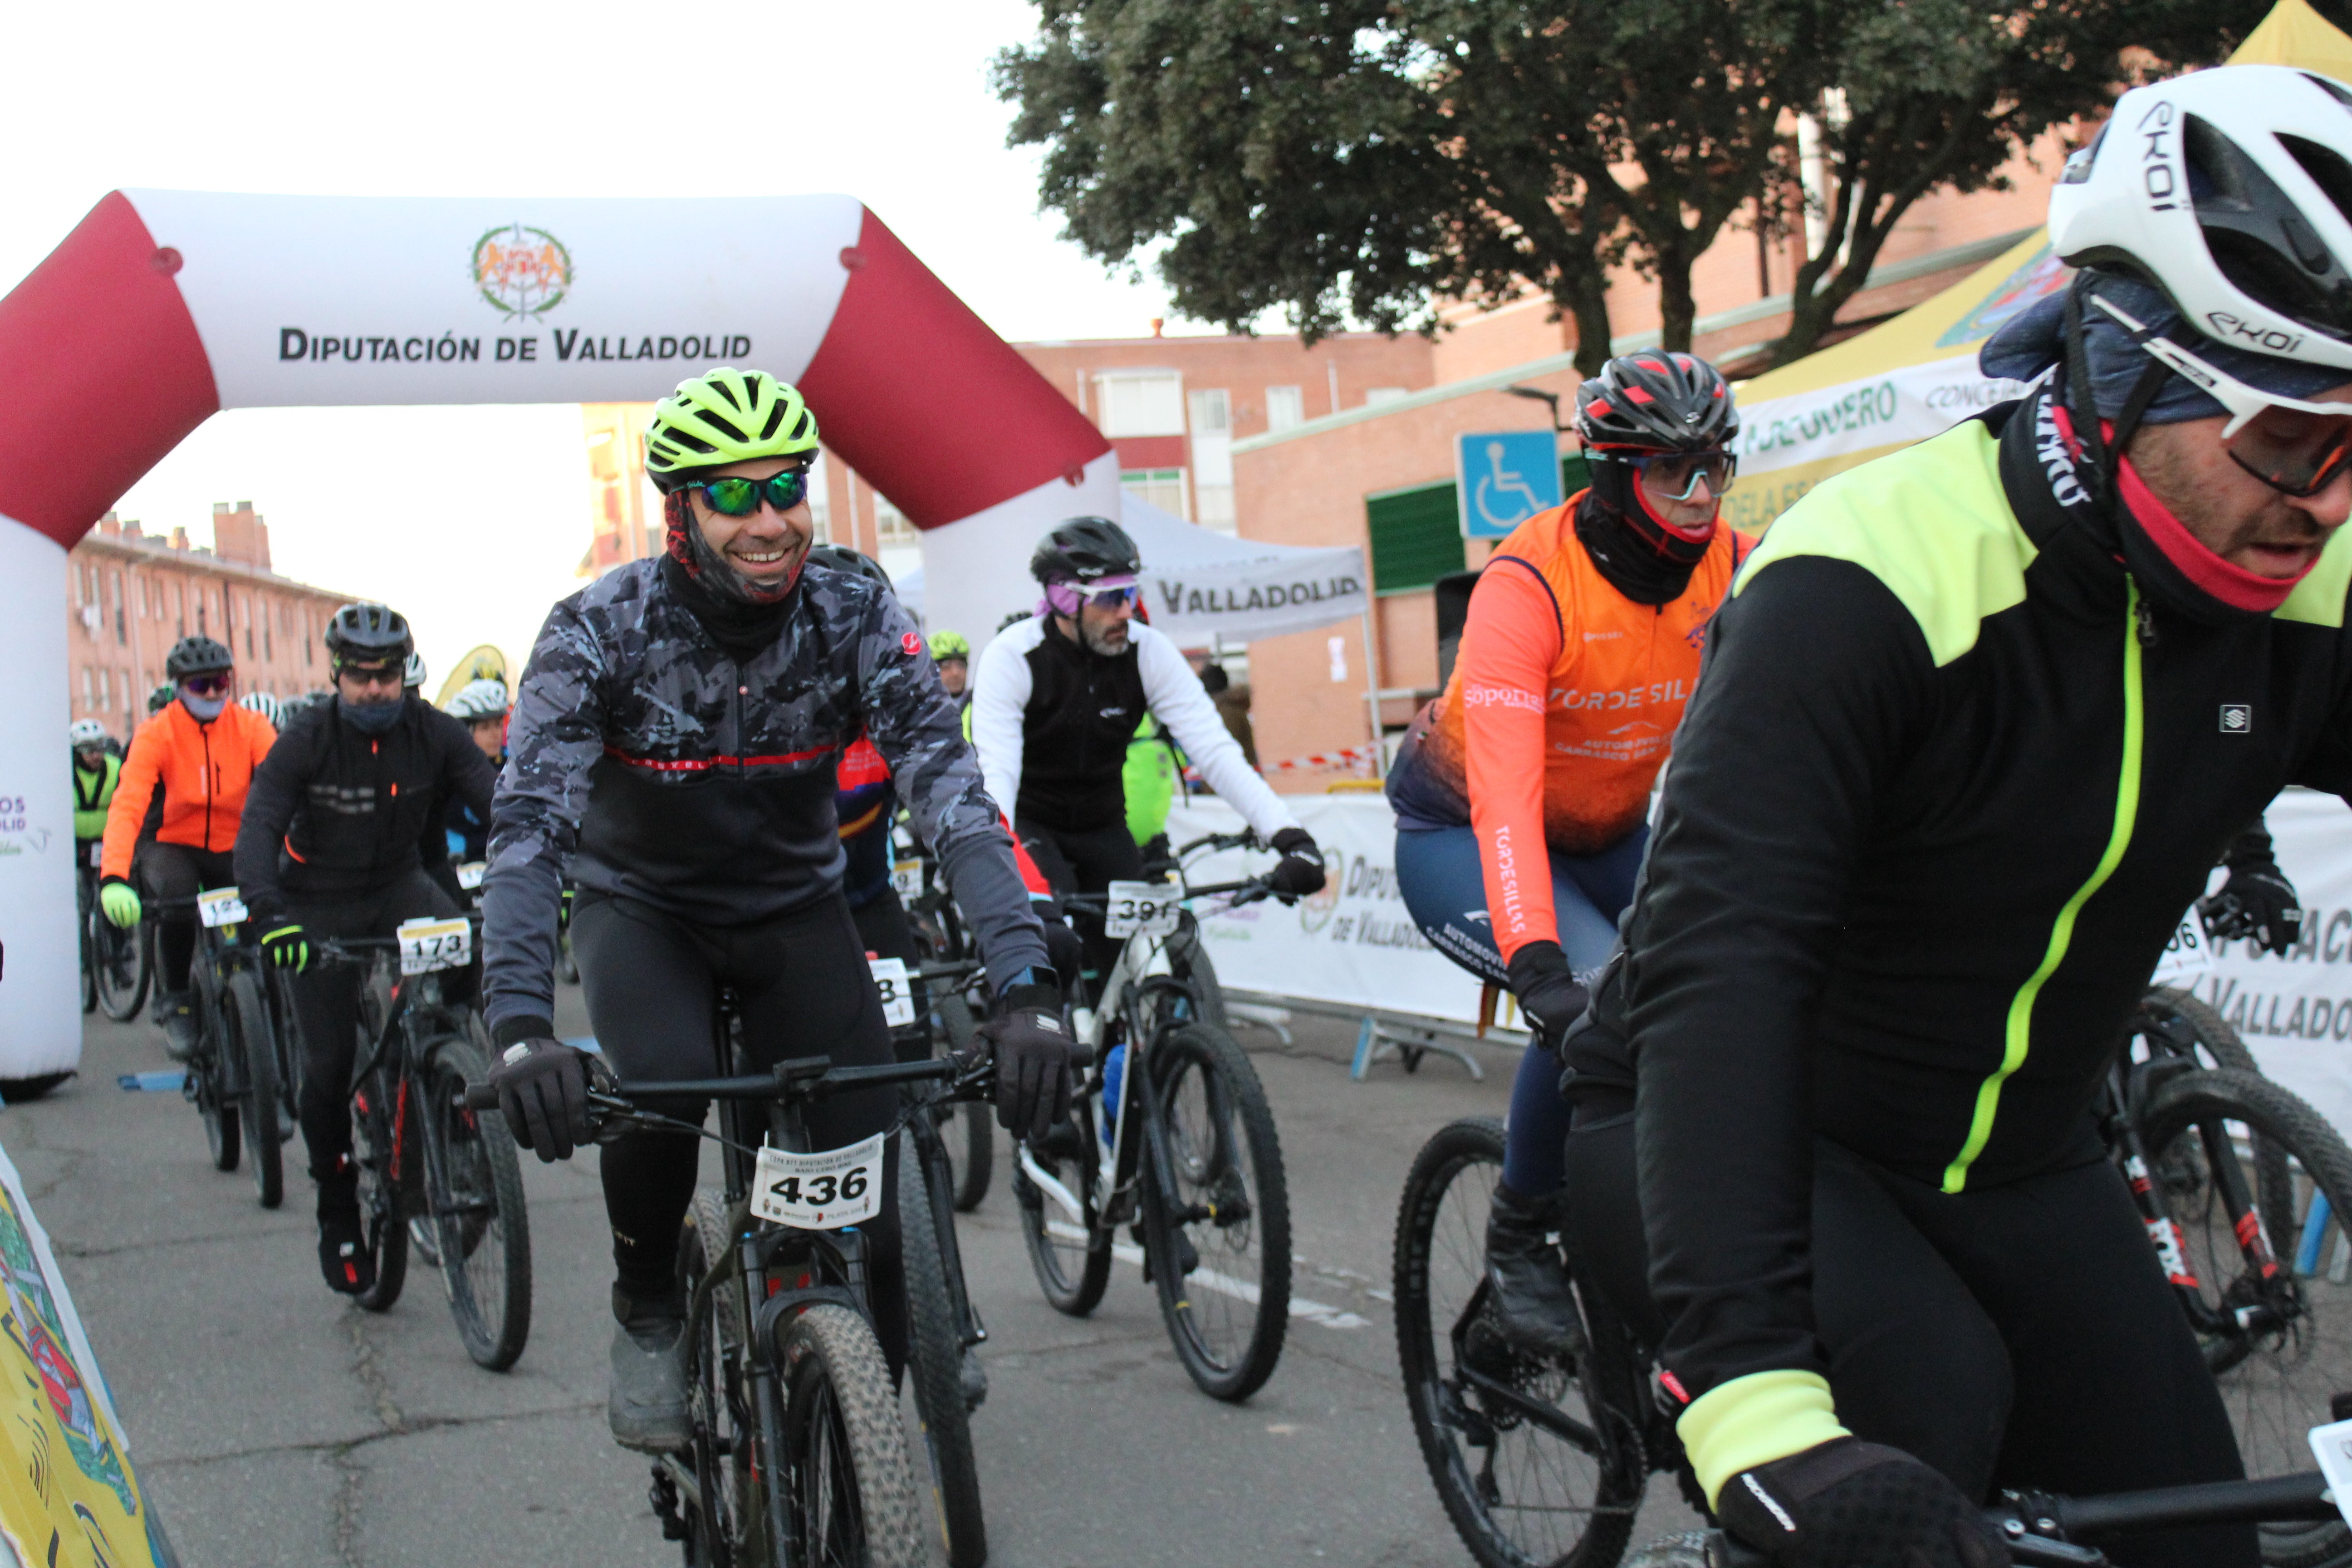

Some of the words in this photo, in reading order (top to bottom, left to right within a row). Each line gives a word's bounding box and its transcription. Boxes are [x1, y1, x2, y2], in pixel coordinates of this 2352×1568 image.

[279, 328, 480, 362] DIPUTACIÓN
[495, 337, 538, 361] DE
[554, 328, 751, 360] VALLADOLID
[1158, 576, 1359, 614] VALLADOLID
[1495, 825, 1527, 934] TORDESILLAS
[412, 935, 461, 957] 173
[770, 1166, 867, 1206] 436
